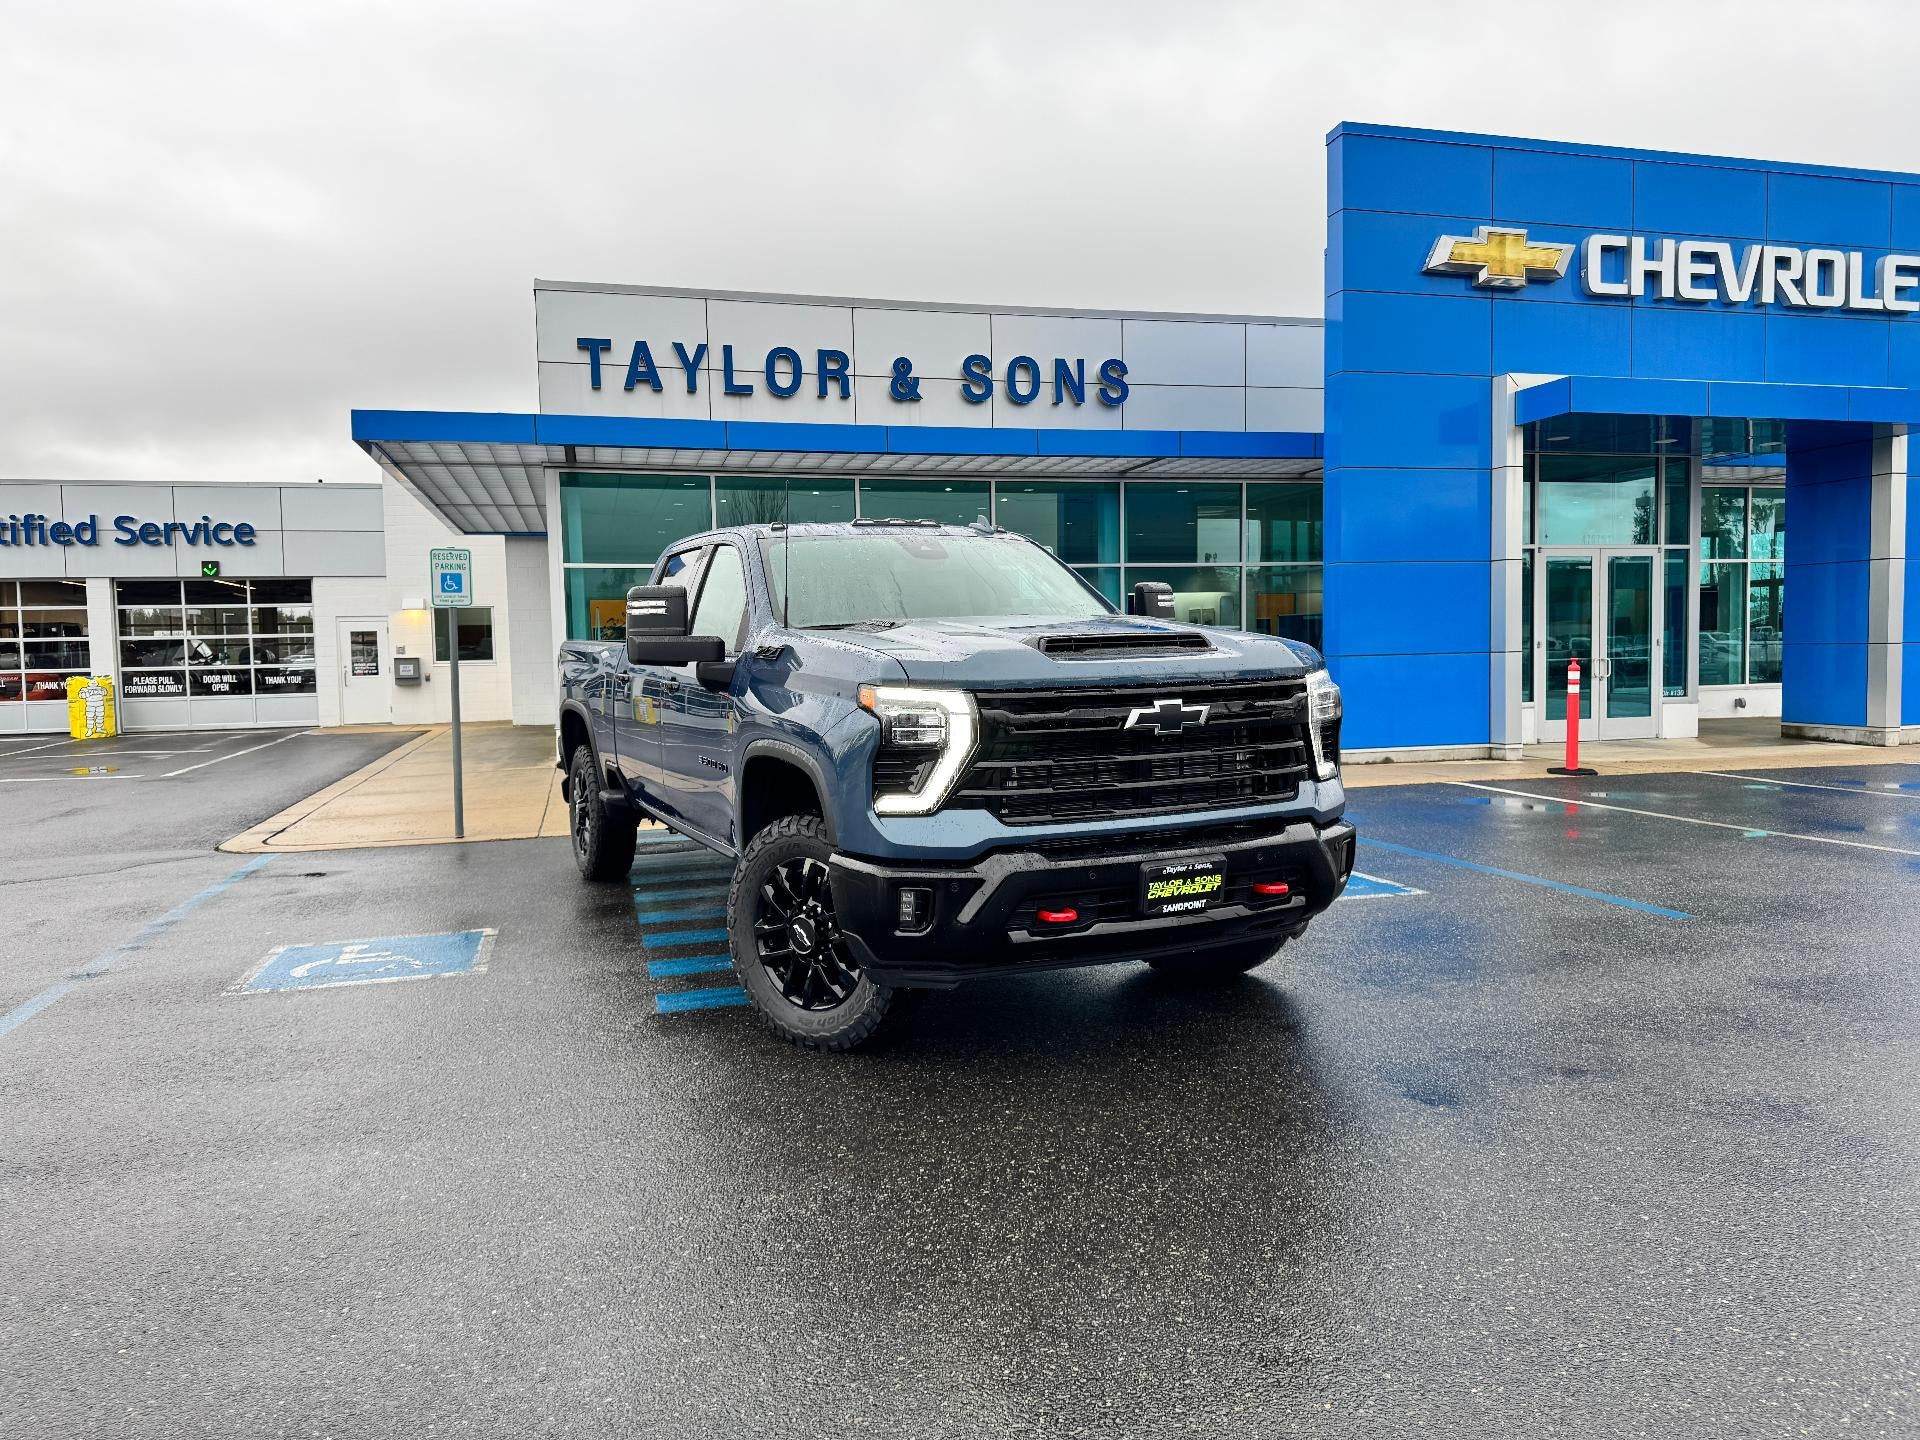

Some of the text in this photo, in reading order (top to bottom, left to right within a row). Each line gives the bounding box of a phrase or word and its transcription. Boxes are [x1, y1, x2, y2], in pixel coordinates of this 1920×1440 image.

[1582, 234, 1920, 311] CHEVROLE
[577, 338, 1130, 406] TAYLOR & SONS
[113, 515, 256, 546] Service
[432, 552, 468, 561] RESERVED
[434, 562, 467, 570] PARKING
[132, 676, 175, 685] PLEASE PULL
[202, 674, 237, 683] DOOR WILL
[264, 675, 302, 684] THANK YOU!
[35, 681, 59, 690] THANK
[124, 684, 183, 694] FORWARD SLOWLY
[211, 683, 229, 691] OPEN
[1148, 874, 1221, 891] TAYLOR & SONS
[1147, 883, 1221, 899] CHEVROLET
[1162, 900, 1207, 913] SANDPOINT
